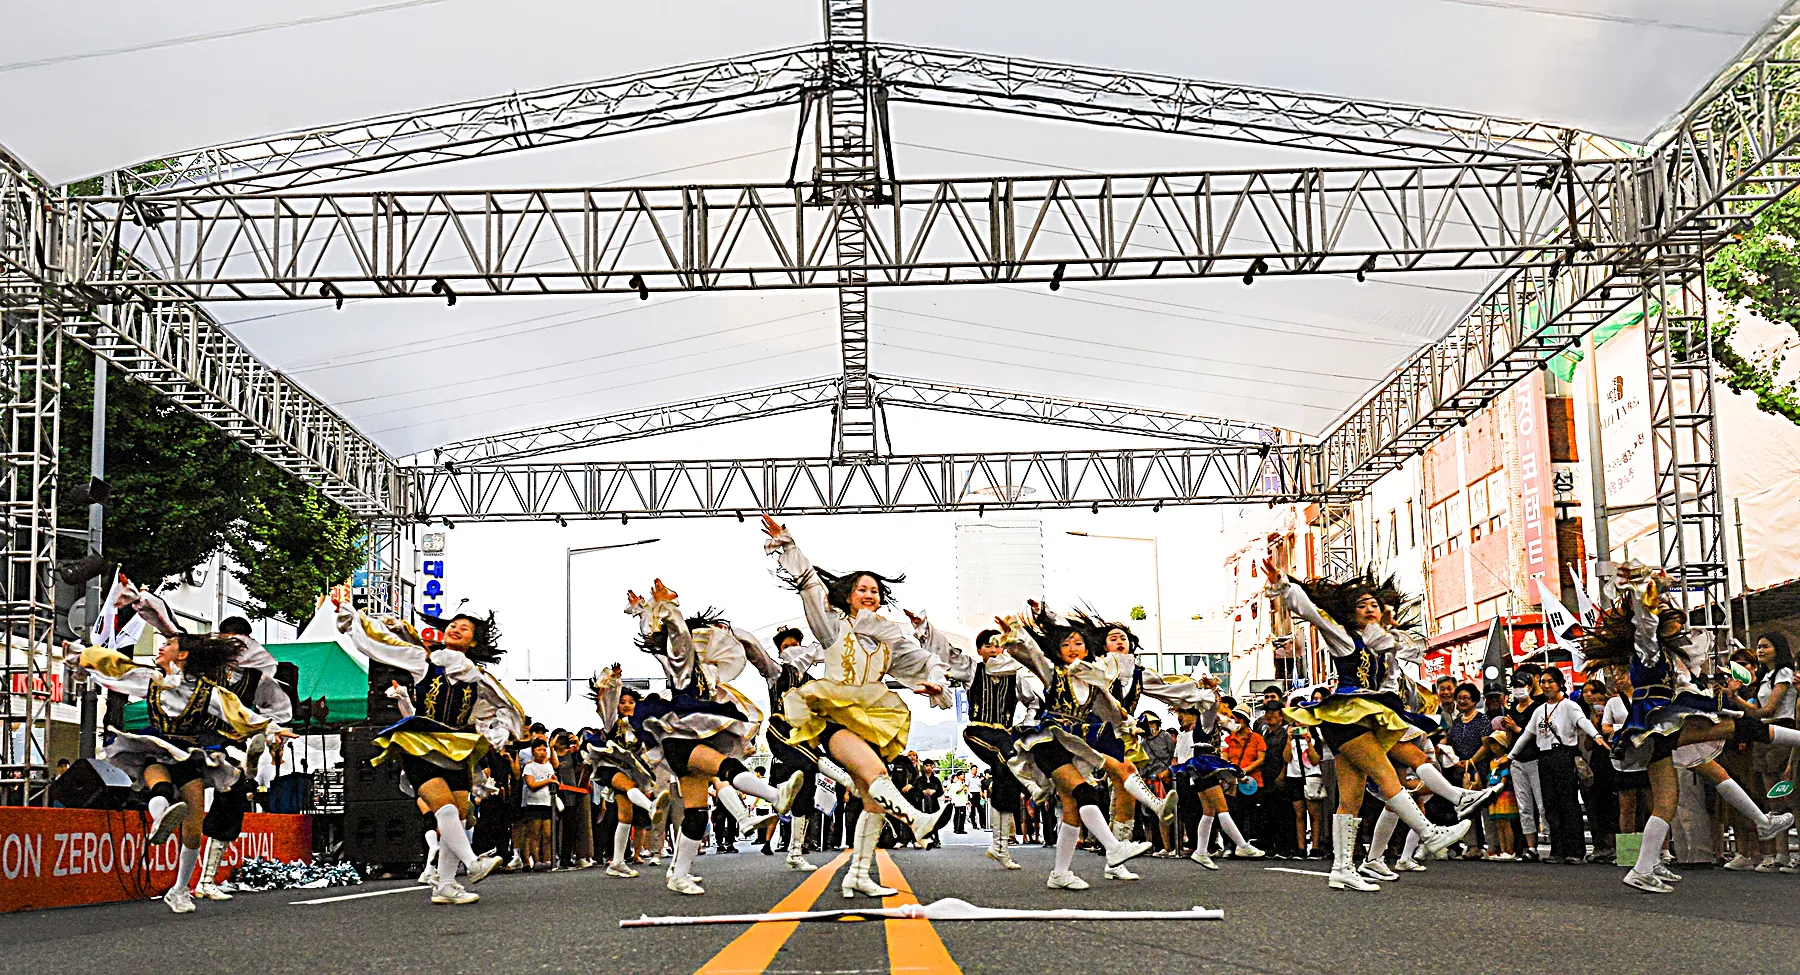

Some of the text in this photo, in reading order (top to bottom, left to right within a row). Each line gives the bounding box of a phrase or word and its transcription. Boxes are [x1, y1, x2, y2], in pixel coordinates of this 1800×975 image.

[0, 832, 274, 880] ON ZERO O'CLO STIVAL
